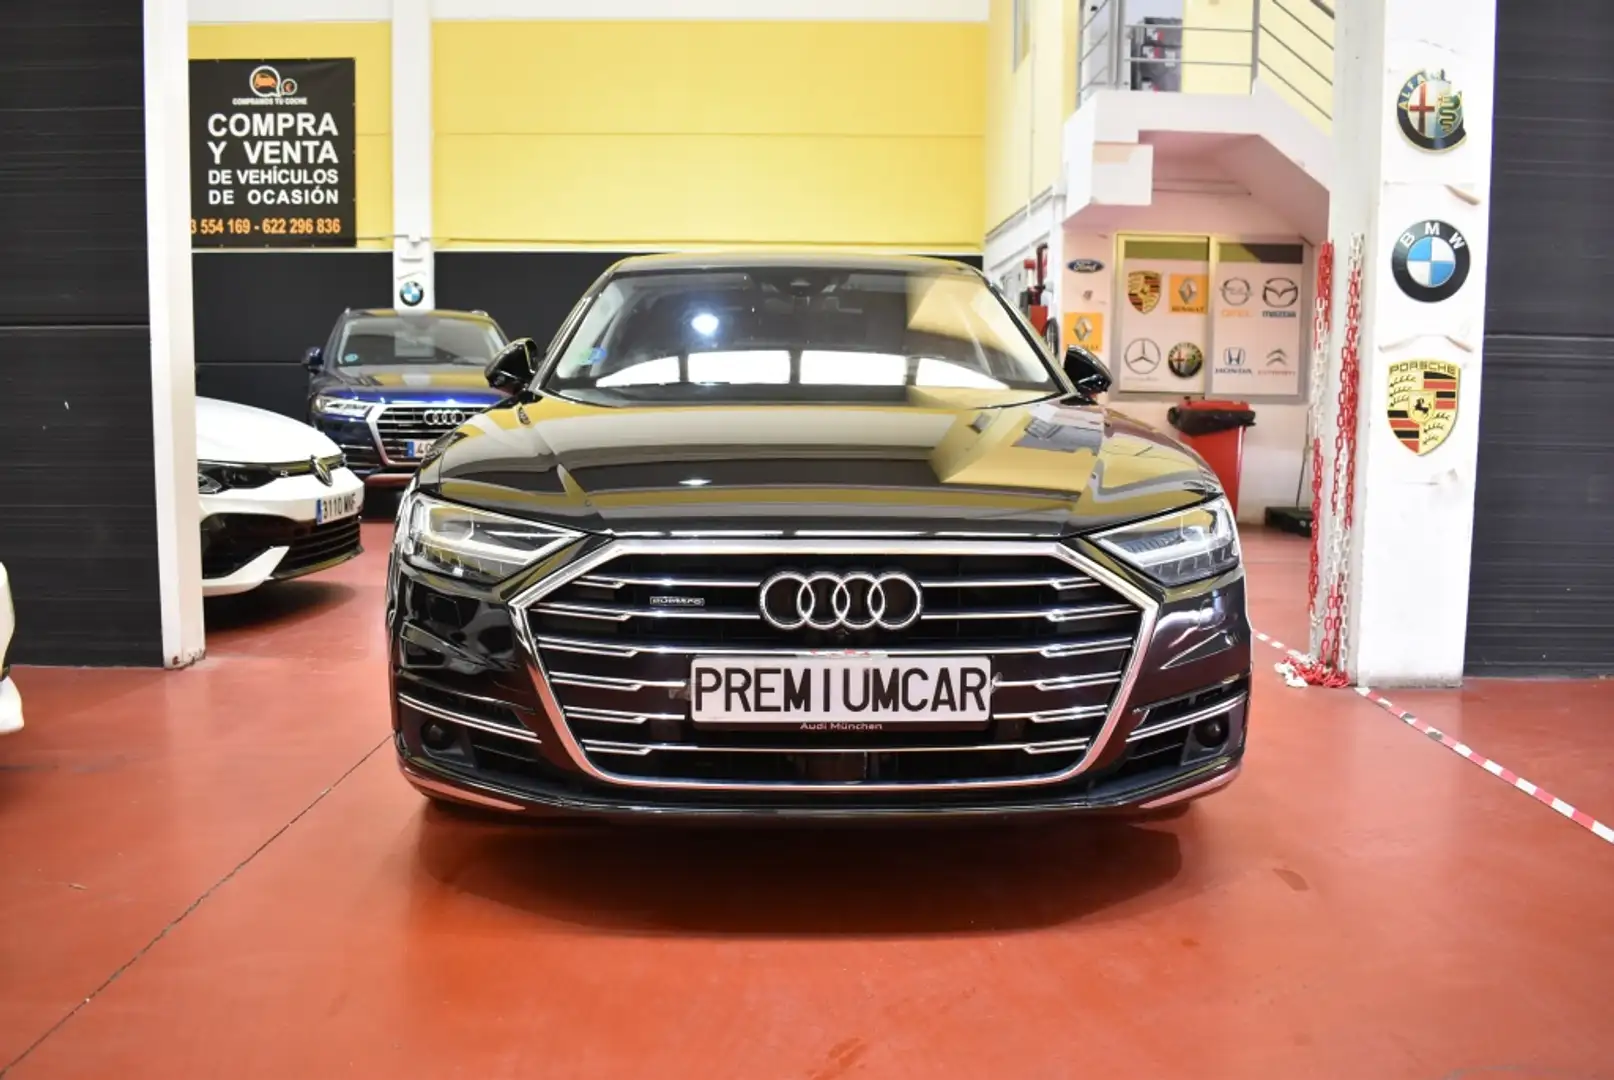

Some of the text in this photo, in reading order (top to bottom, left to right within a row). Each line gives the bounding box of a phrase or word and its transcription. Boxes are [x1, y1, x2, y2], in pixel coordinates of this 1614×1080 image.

[207, 112, 339, 137] COMPRA
[207, 140, 339, 164] Y VENTA
[208, 165, 339, 185] DE VEHÍCULOS
[208, 186, 339, 205] DE OCASIÓN
[200, 218, 224, 234] 554
[227, 218, 251, 234] 169
[262, 218, 286, 234] 622
[289, 218, 313, 234] 296
[316, 218, 341, 234] 836
[1399, 221, 1466, 249] BMW
[1388, 361, 1457, 376] PORSCHE
[323, 497, 343, 519] 3110
[694, 667, 986, 713] PREMIUMCAR
[800, 722, 882, 730] Audi München
